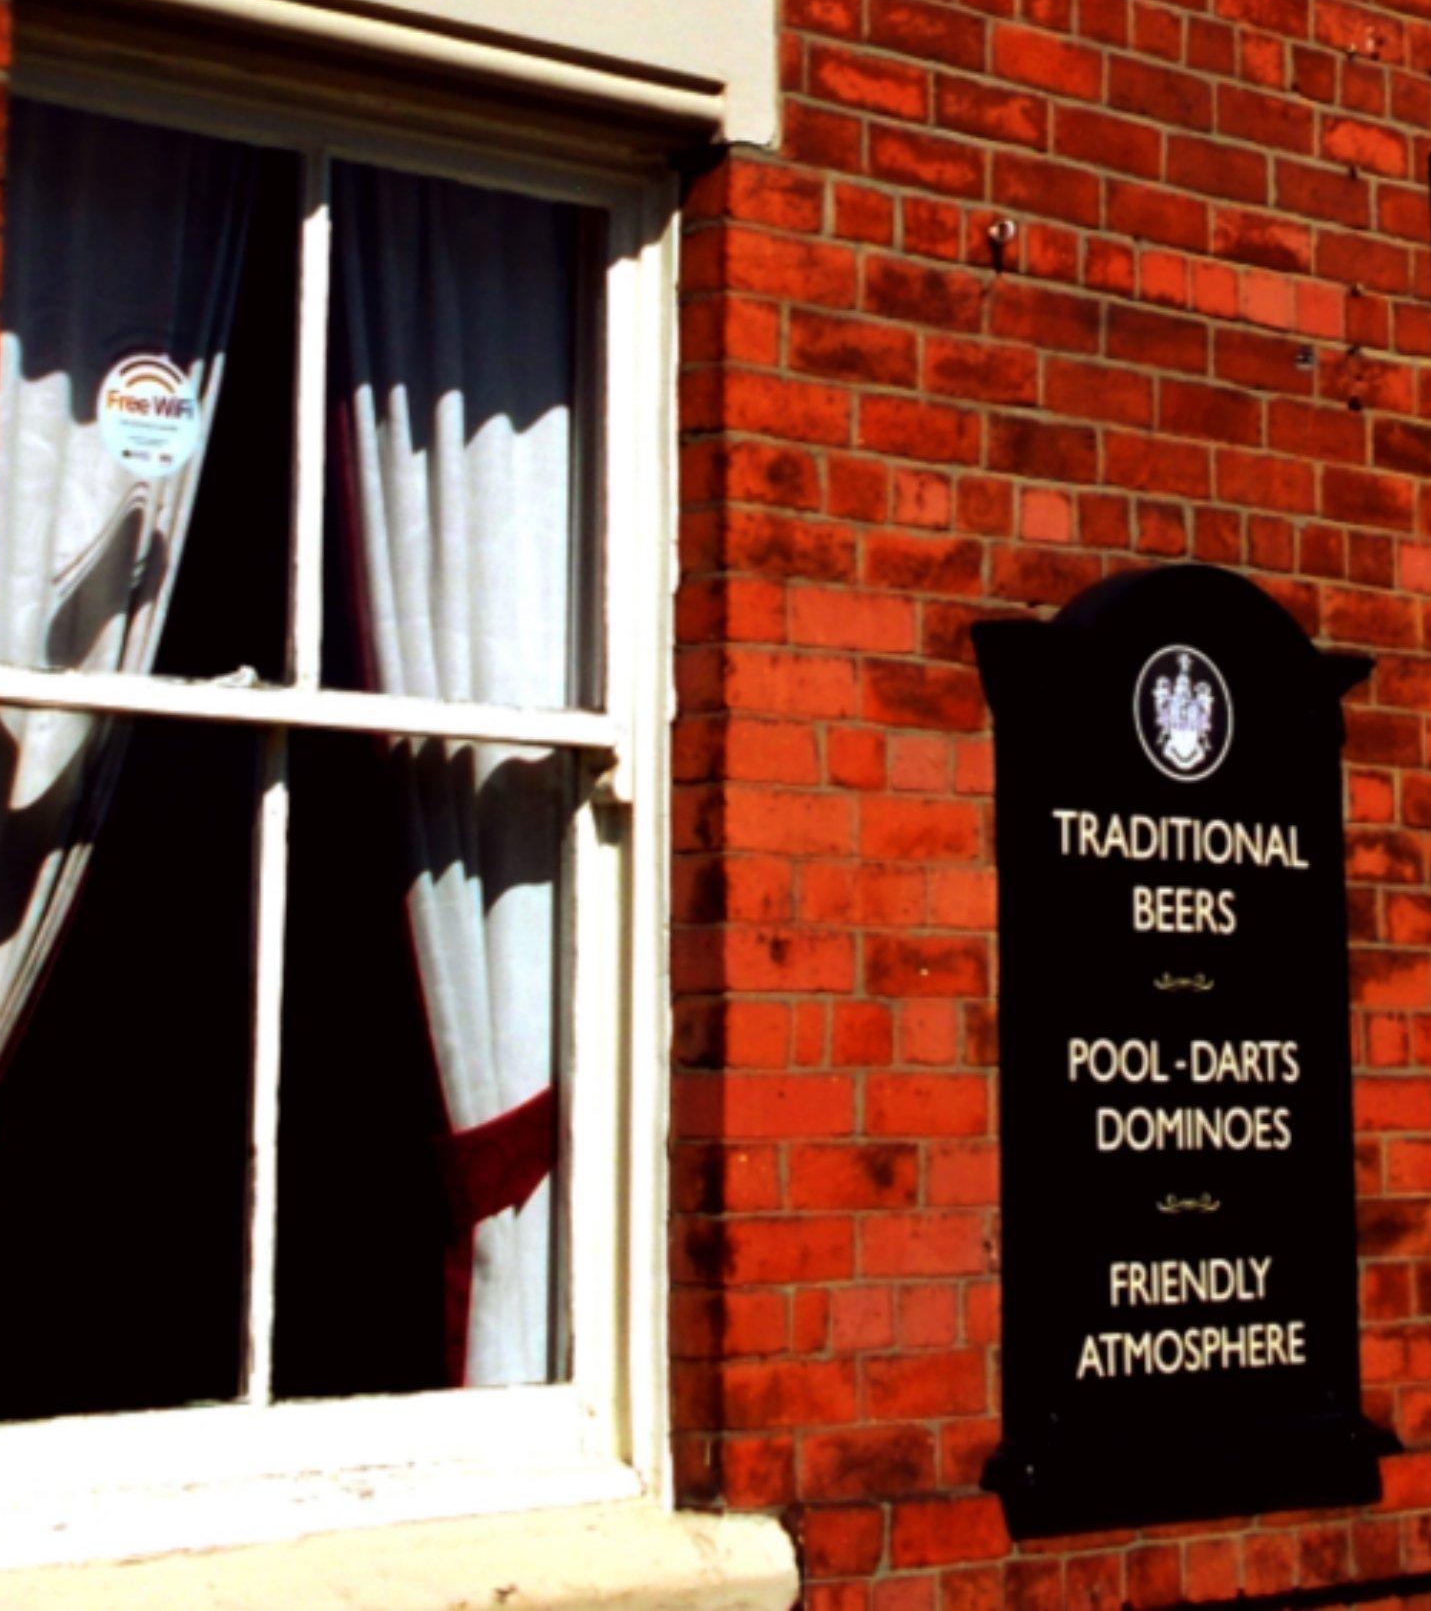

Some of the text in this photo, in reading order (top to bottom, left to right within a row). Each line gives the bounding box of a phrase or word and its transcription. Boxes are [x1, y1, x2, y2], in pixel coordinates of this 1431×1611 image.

[106, 390, 149, 415] Free
[1051, 807, 1311, 871] TRADITIONAL
[1132, 884, 1238, 936] BEERS
[1096, 1106, 1292, 1152] DOMINOES
[1109, 1256, 1272, 1307] FRIENDLY
[1076, 1320, 1307, 1380] ATMOSPHERE
